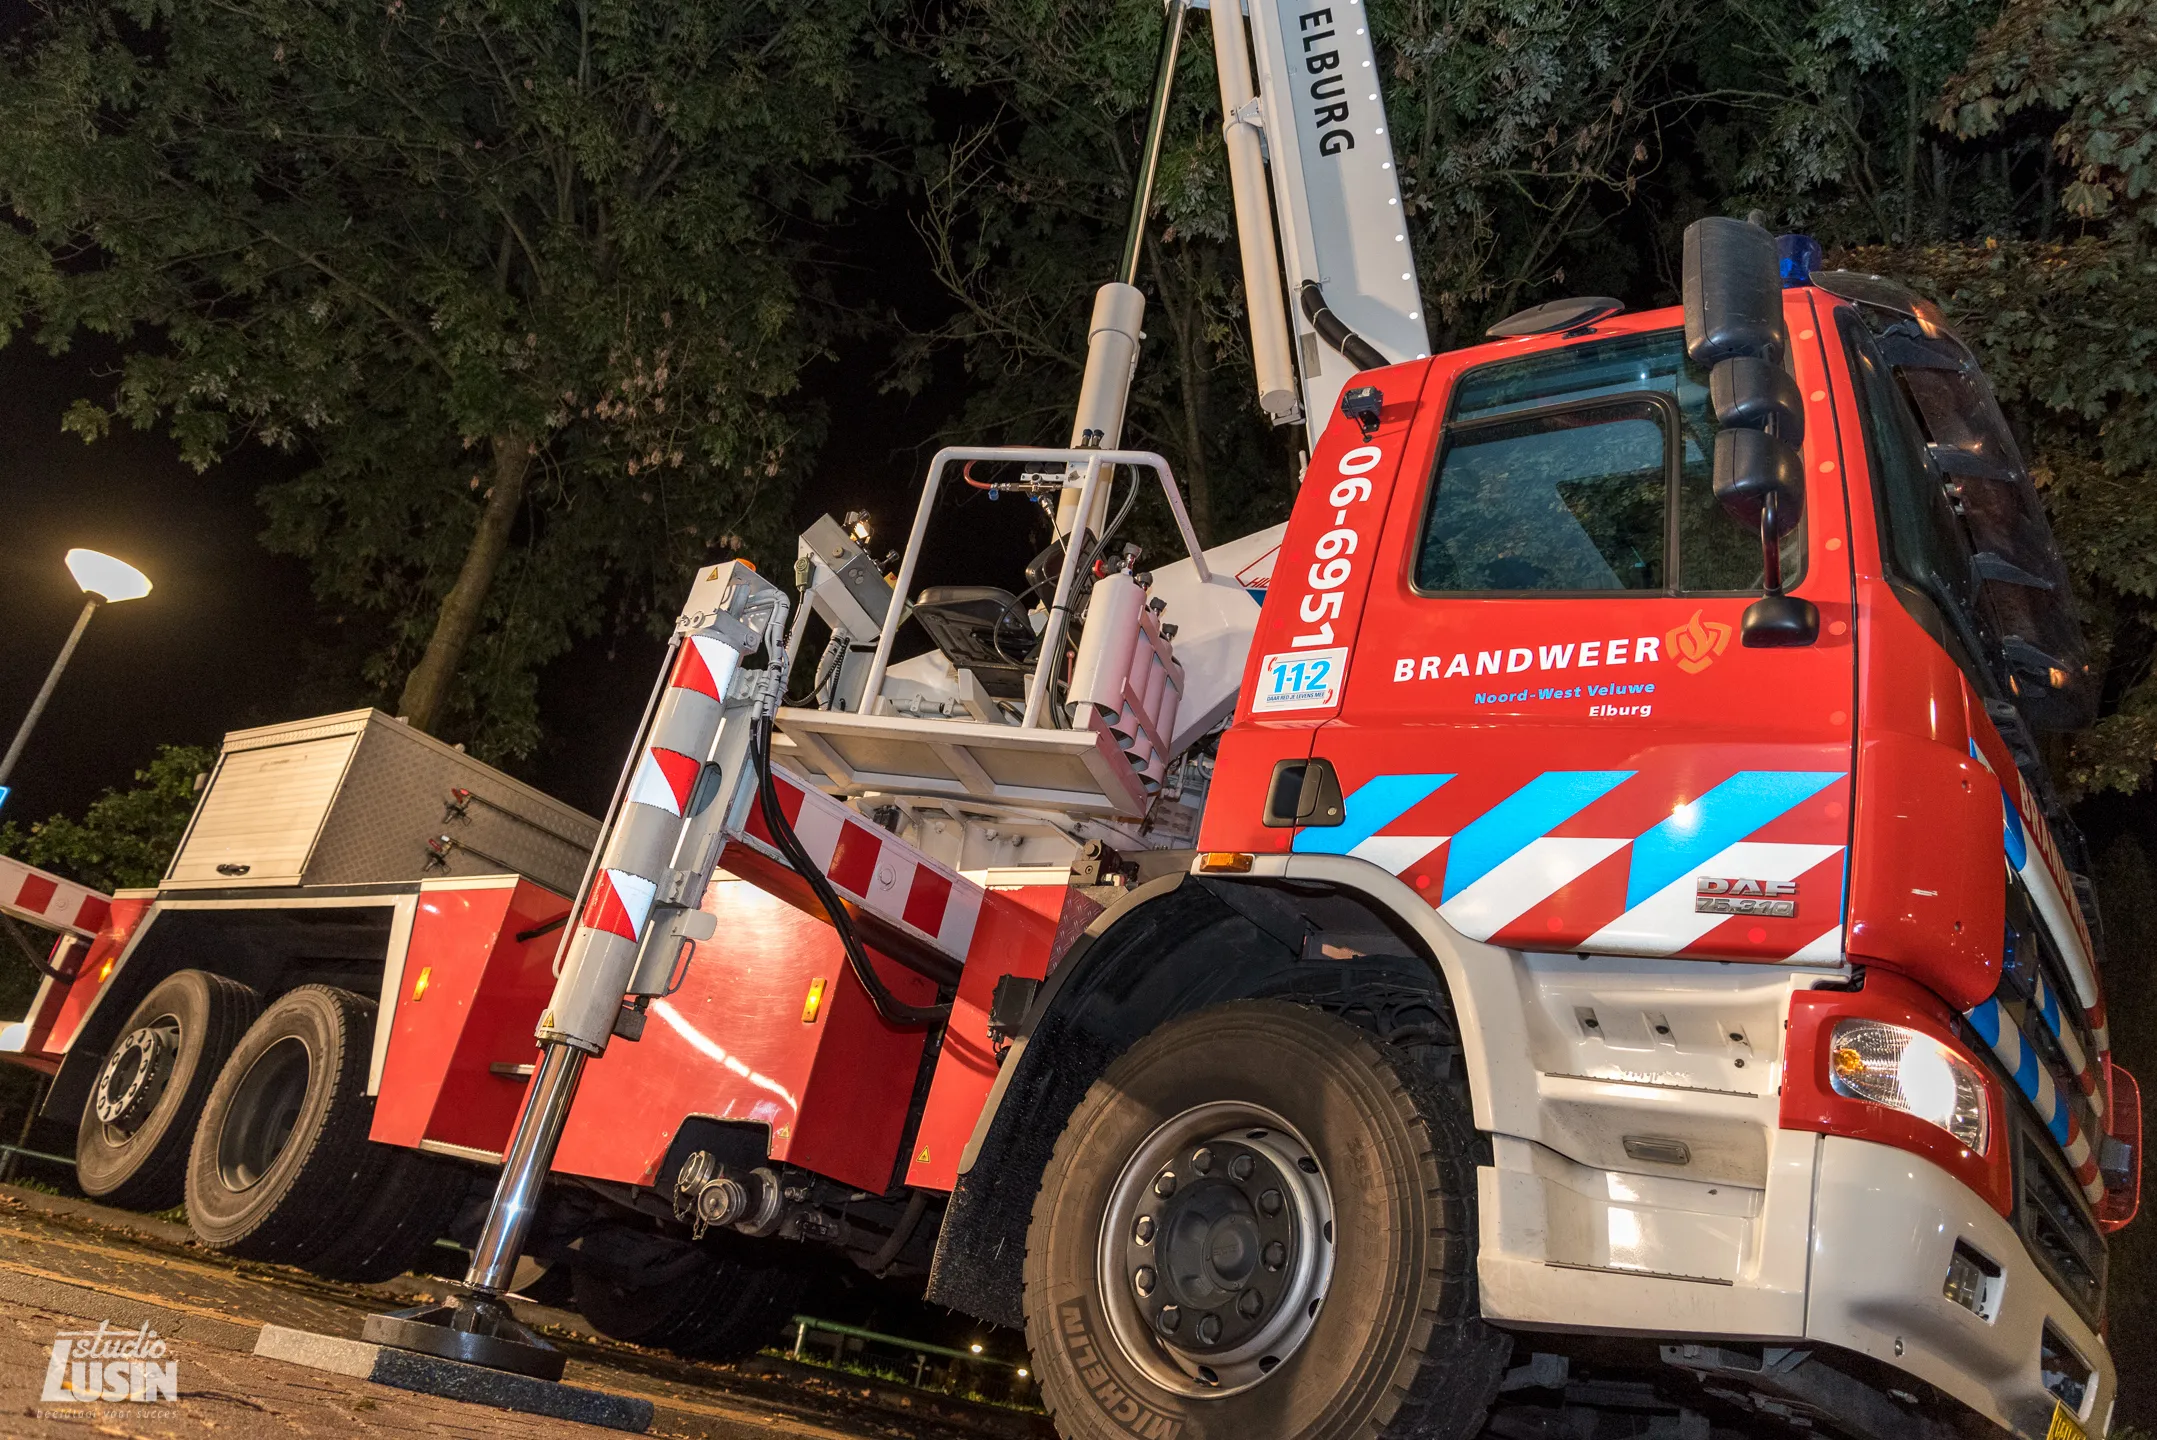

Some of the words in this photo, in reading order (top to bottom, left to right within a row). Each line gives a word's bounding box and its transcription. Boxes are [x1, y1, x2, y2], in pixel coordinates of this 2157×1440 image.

[1299, 8, 1355, 157] ELBURG
[1291, 446, 1382, 648] 06-6951
[1393, 636, 1661, 683] BRANDWEER
[1272, 660, 1331, 693] 1-1-2
[1474, 686, 1581, 705] Noord-West
[1587, 682, 1656, 698] Veluwe
[1588, 704, 1653, 718] Elburg
[1697, 877, 1796, 897] DAF
[1697, 897, 1794, 916] 75.310
[1061, 1306, 1183, 1440] MICHELIN
